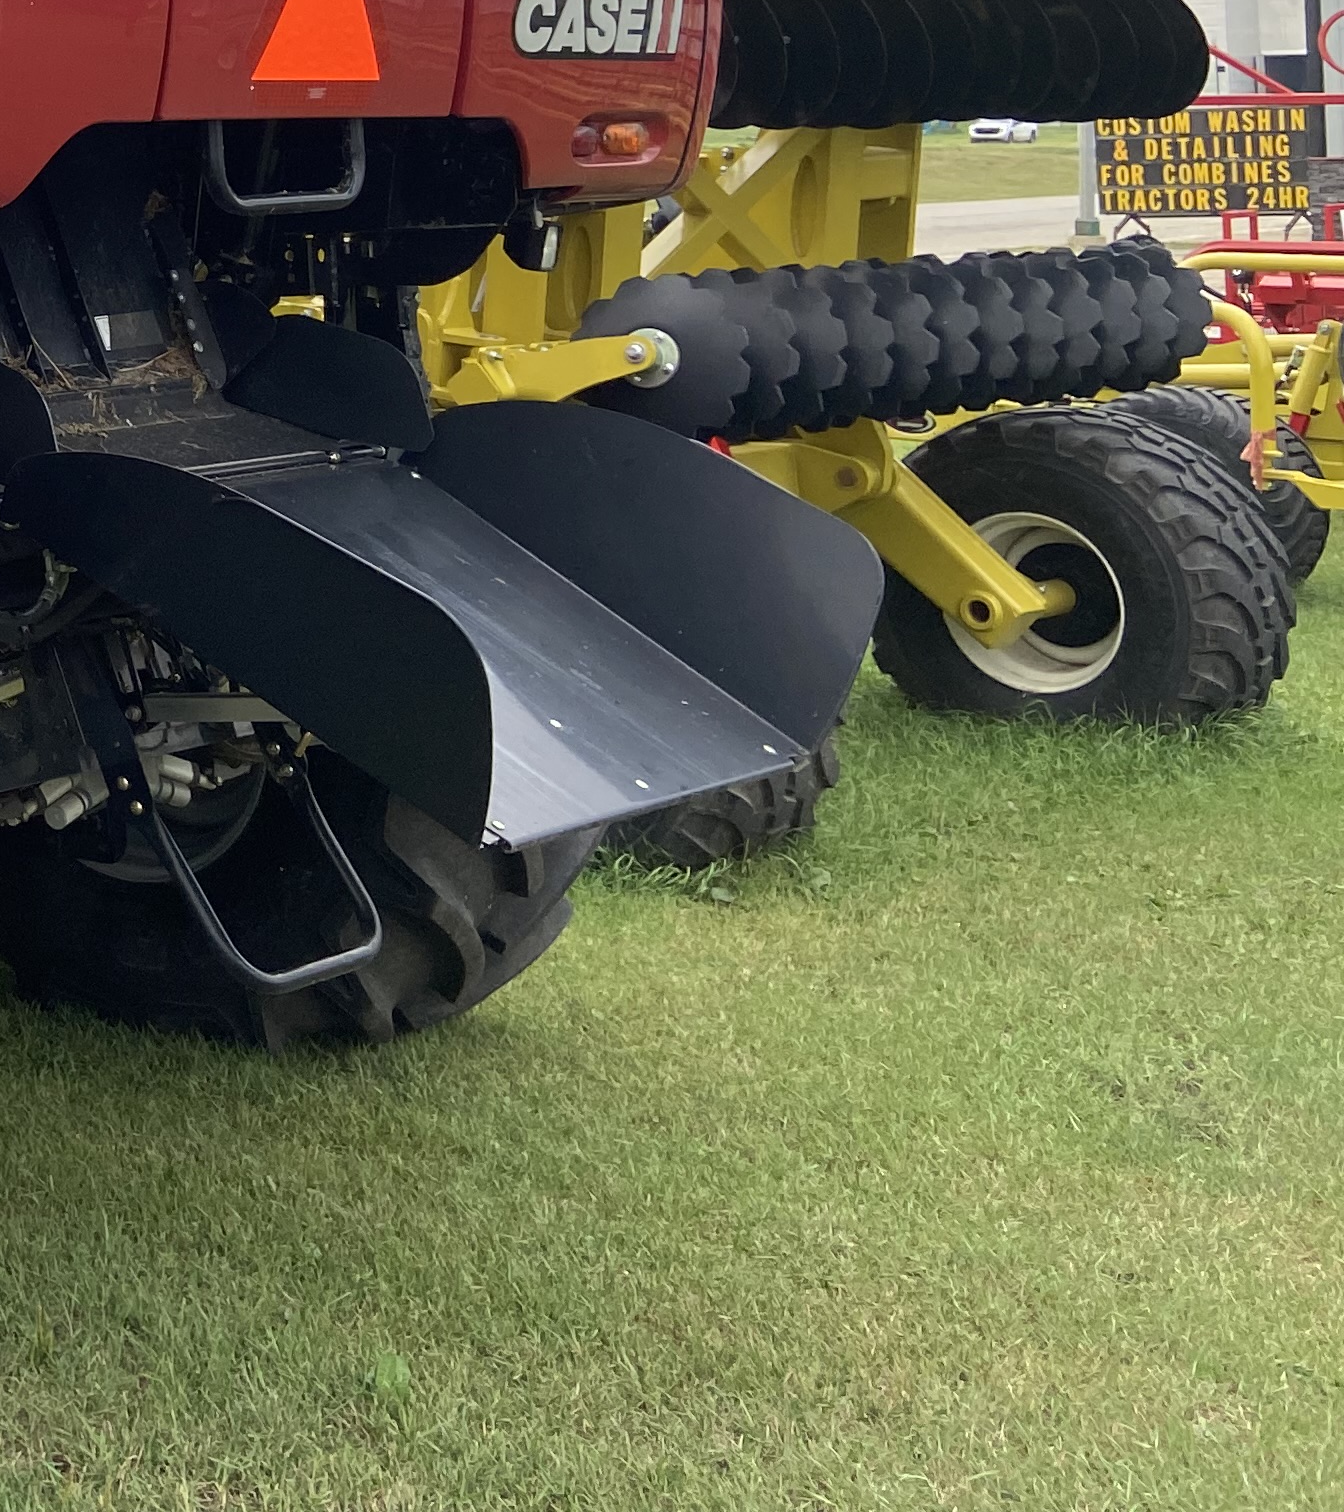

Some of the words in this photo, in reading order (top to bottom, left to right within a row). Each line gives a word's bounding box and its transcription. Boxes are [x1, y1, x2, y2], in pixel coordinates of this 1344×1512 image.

[1207, 108, 1306, 133] WASHIN
[1113, 138, 1128, 161] &
[1145, 134, 1290, 160] DETAILING
[1100, 163, 1144, 186] FOR
[1163, 160, 1291, 185] COMBINES
[1101, 186, 1228, 211] TRACTORS
[1247, 186, 1310, 209] 24HR
